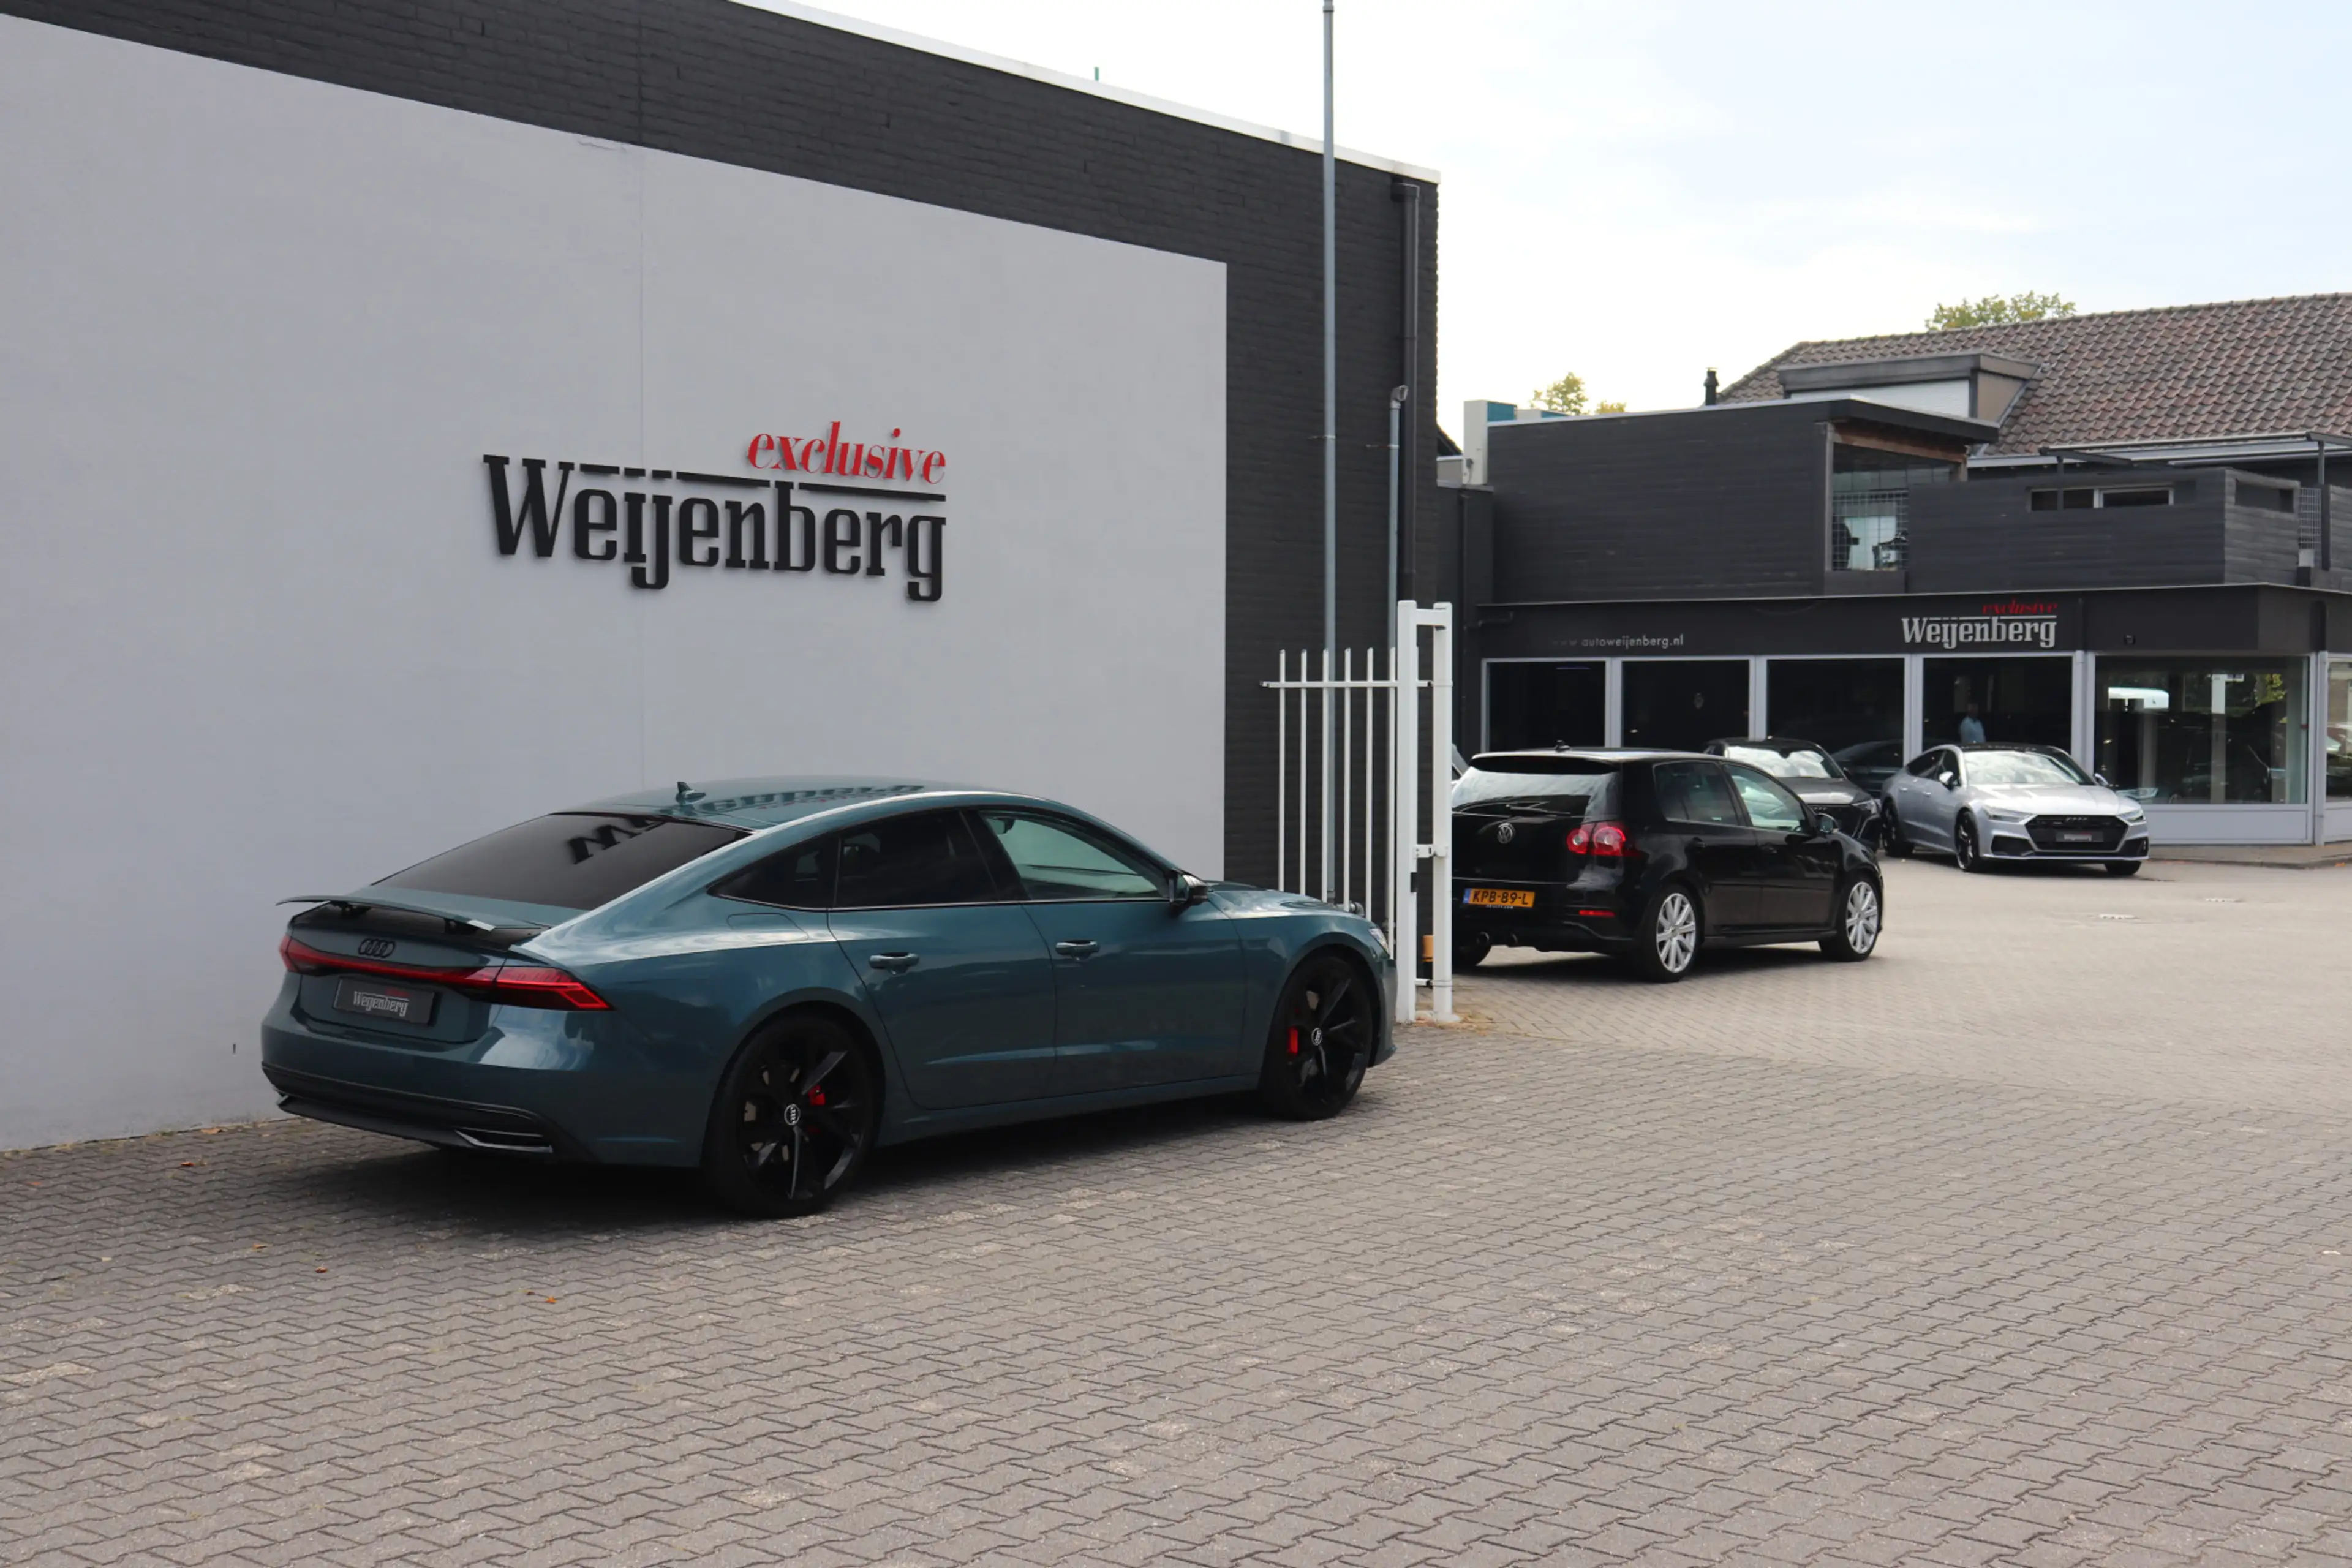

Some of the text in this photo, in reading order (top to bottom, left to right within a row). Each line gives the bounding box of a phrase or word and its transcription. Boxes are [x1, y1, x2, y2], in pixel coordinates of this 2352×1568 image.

[747, 421, 946, 484] exclusive
[483, 454, 946, 602] Weijenberg
[1581, 633, 1684, 650] autoweijenberg.nl
[1901, 615, 2057, 649] Weijenberg
[1472, 890, 1529, 905] KPB-89-L
